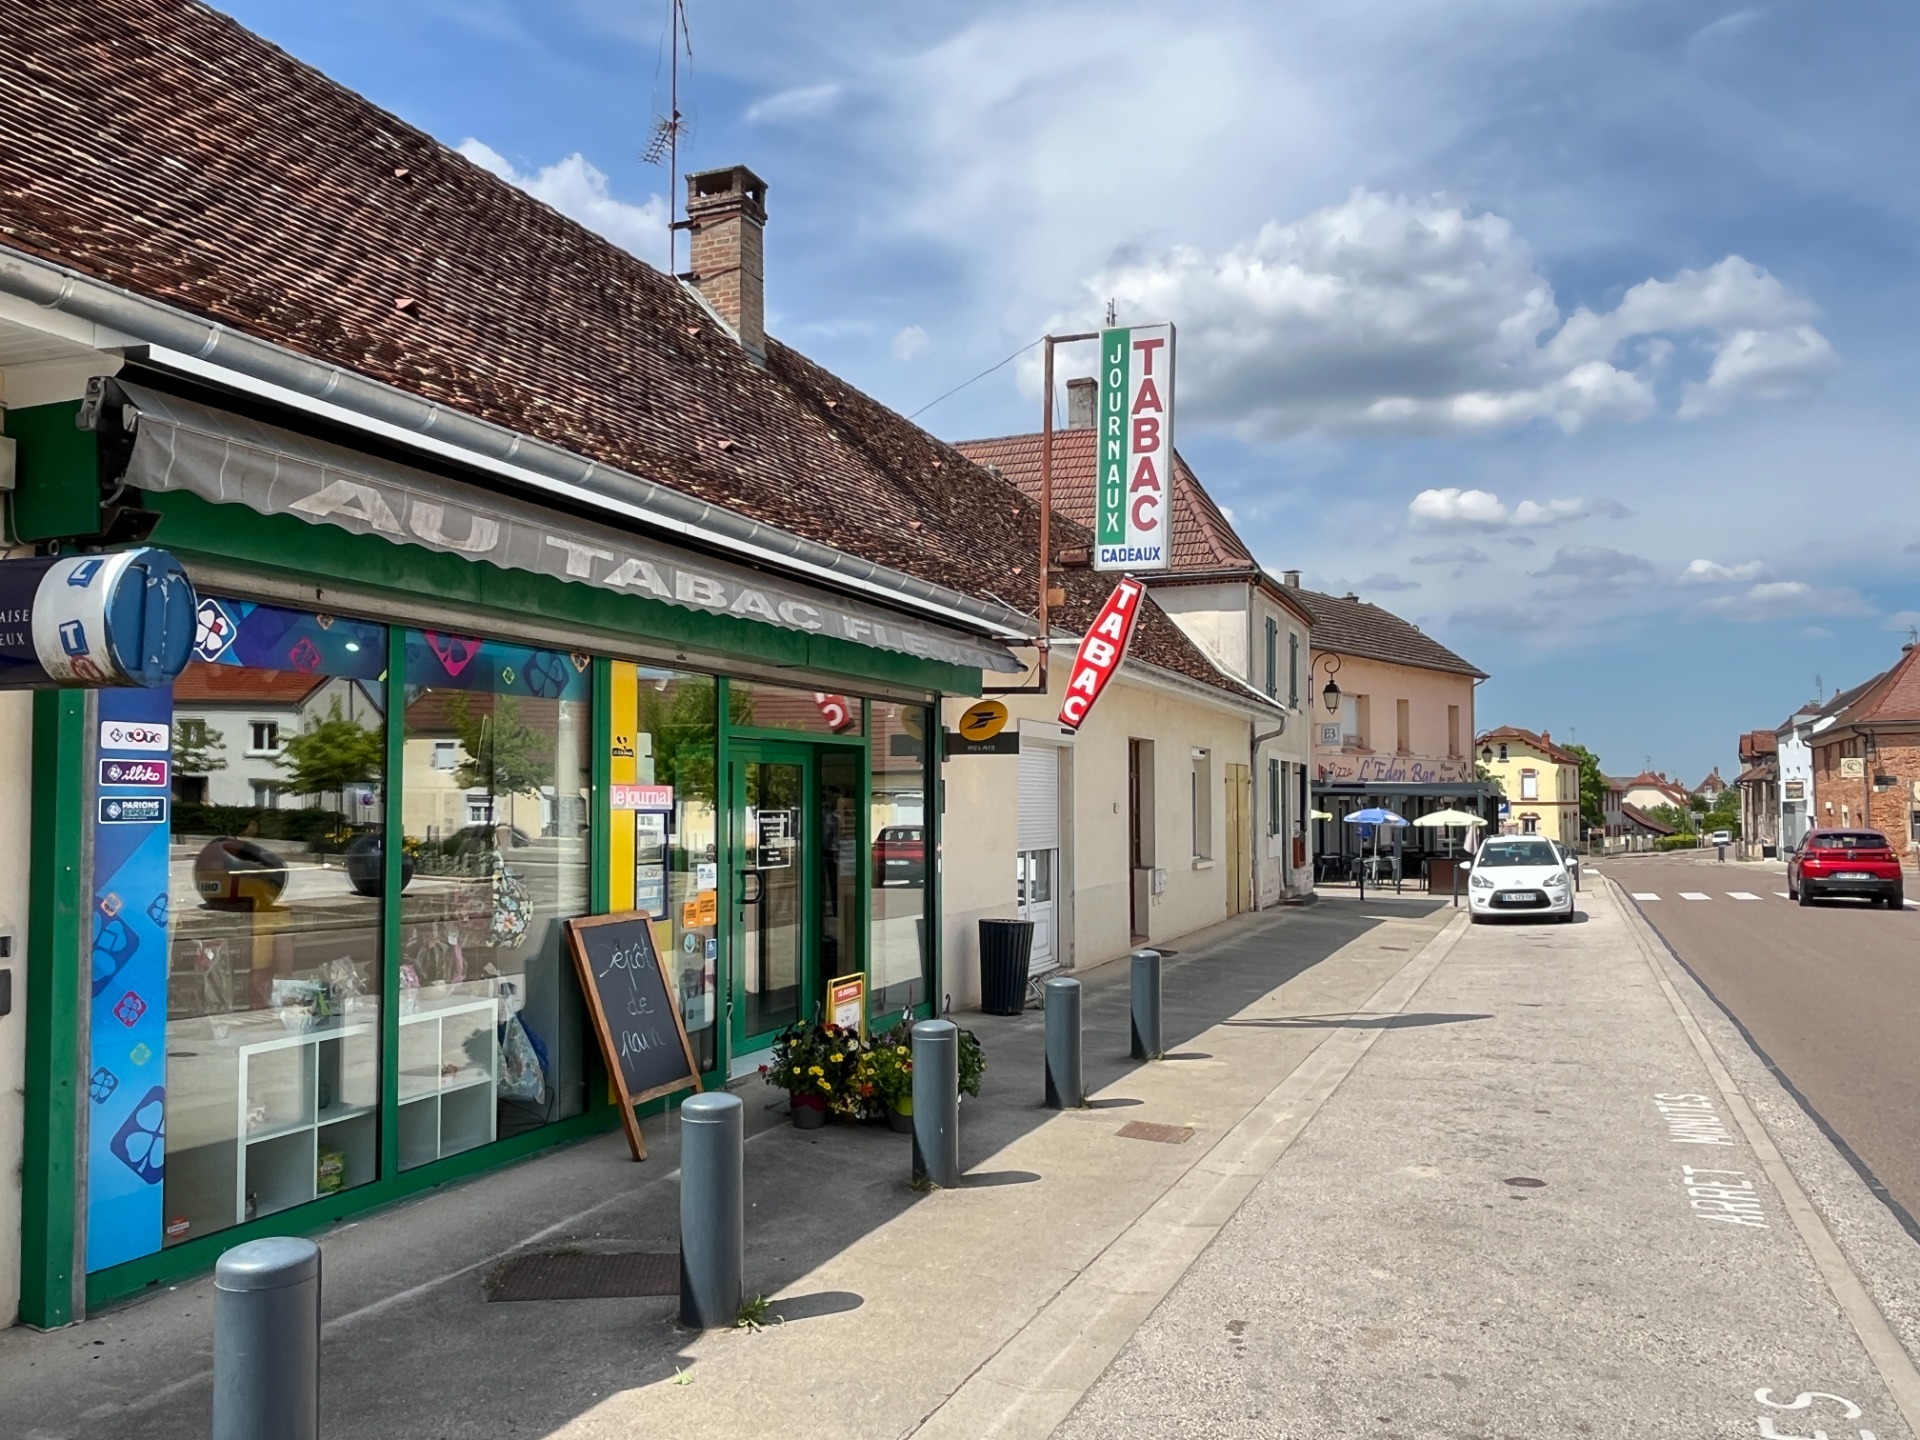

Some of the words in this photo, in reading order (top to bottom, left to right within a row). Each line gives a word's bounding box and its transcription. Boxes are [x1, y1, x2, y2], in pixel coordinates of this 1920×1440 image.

[1106, 343, 1122, 533] JOURNAUX
[1130, 338, 1164, 532] TABAC
[288, 479, 499, 553] AU
[546, 535, 822, 630] TABAC
[1101, 547, 1161, 563] CADEAUX
[1063, 583, 1138, 721] TABAC
[125, 728, 162, 743] LOTO
[121, 764, 160, 781] illiko
[1411, 762, 1436, 783] Bar
[122, 801, 160, 809] PARIONS
